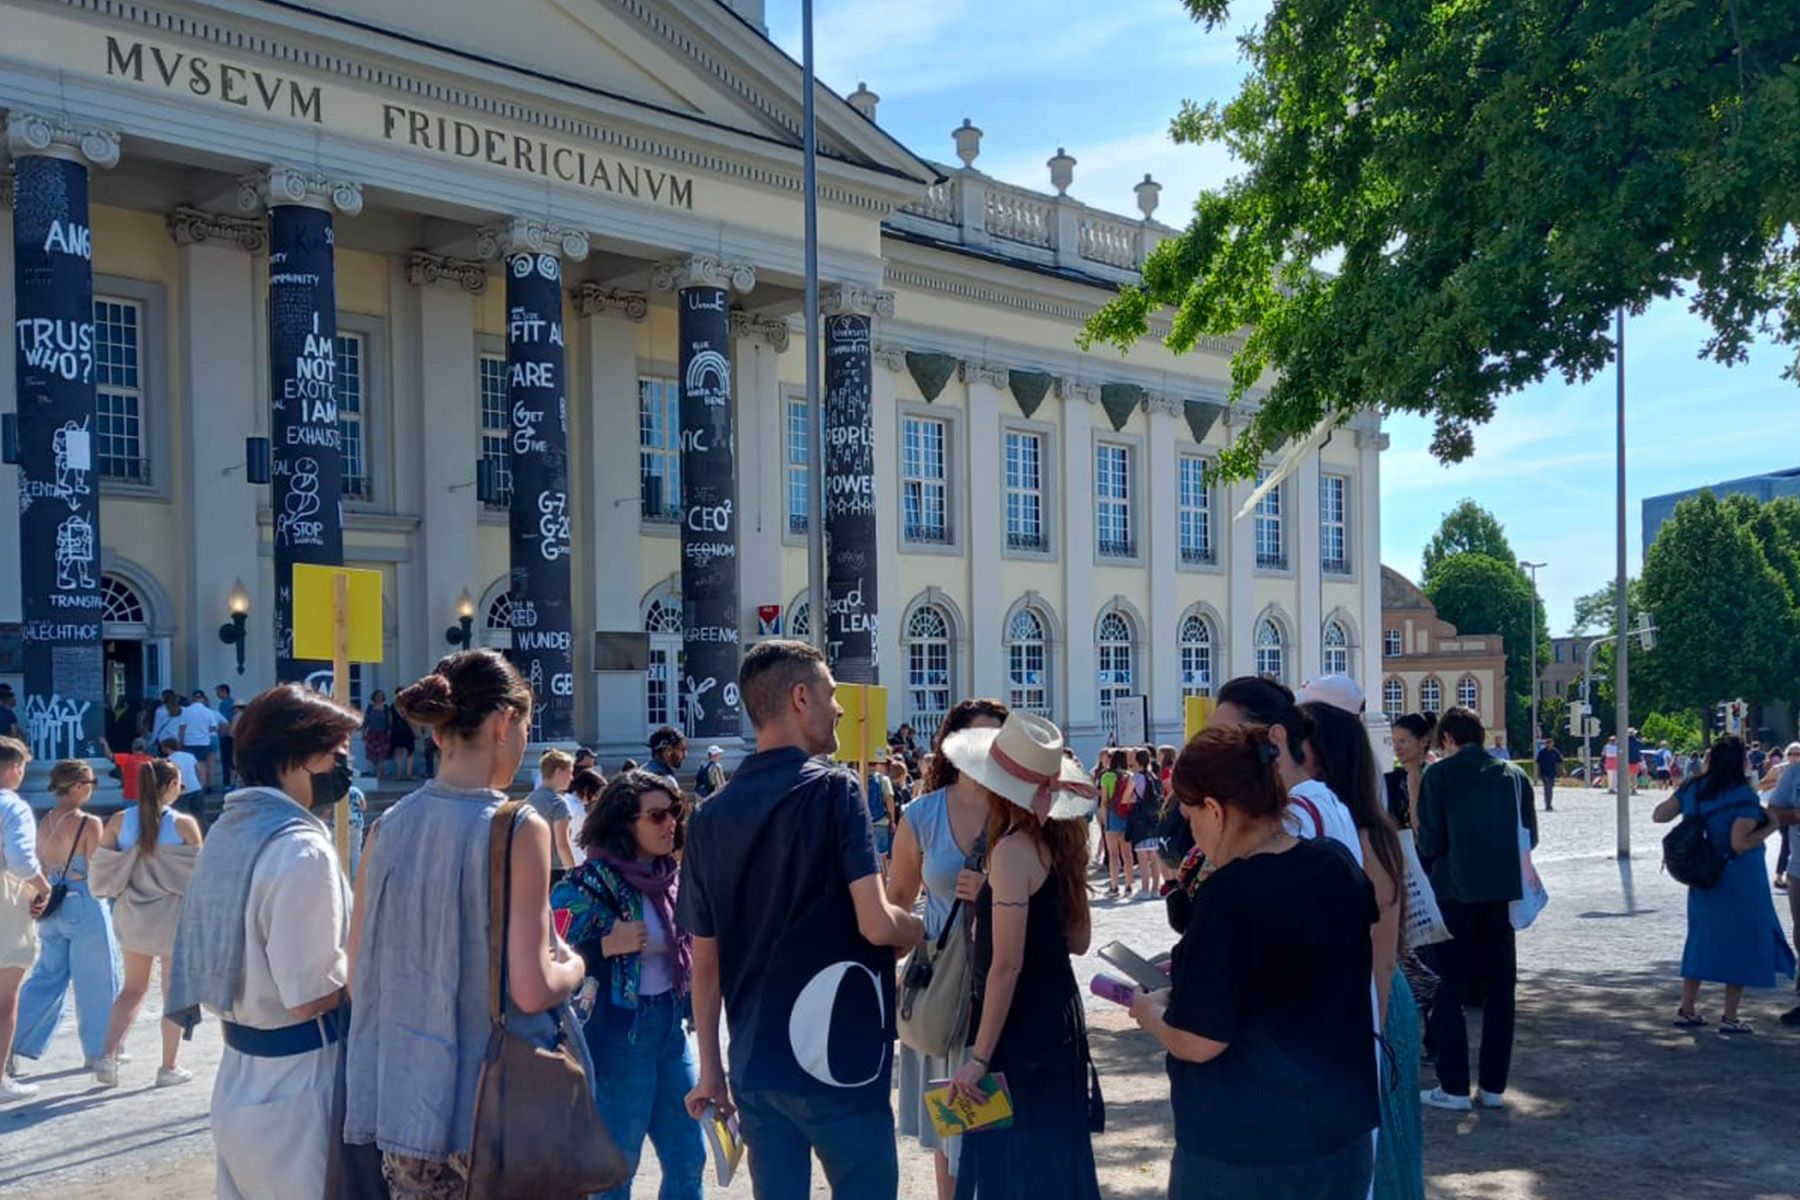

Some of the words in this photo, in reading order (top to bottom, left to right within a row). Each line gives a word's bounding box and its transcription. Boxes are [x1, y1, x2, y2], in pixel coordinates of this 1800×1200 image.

[105, 36, 323, 123] MVSEVM
[382, 104, 694, 210] FRIDERICIANVM
[313, 311, 319, 334] I
[511, 320, 546, 343] FIT
[303, 333, 333, 360] AM
[25, 347, 92, 384] WHO?
[296, 356, 336, 382] NOT
[302, 398, 308, 422] I
[312, 400, 338, 426] AM
[293, 521, 324, 537] STOP
